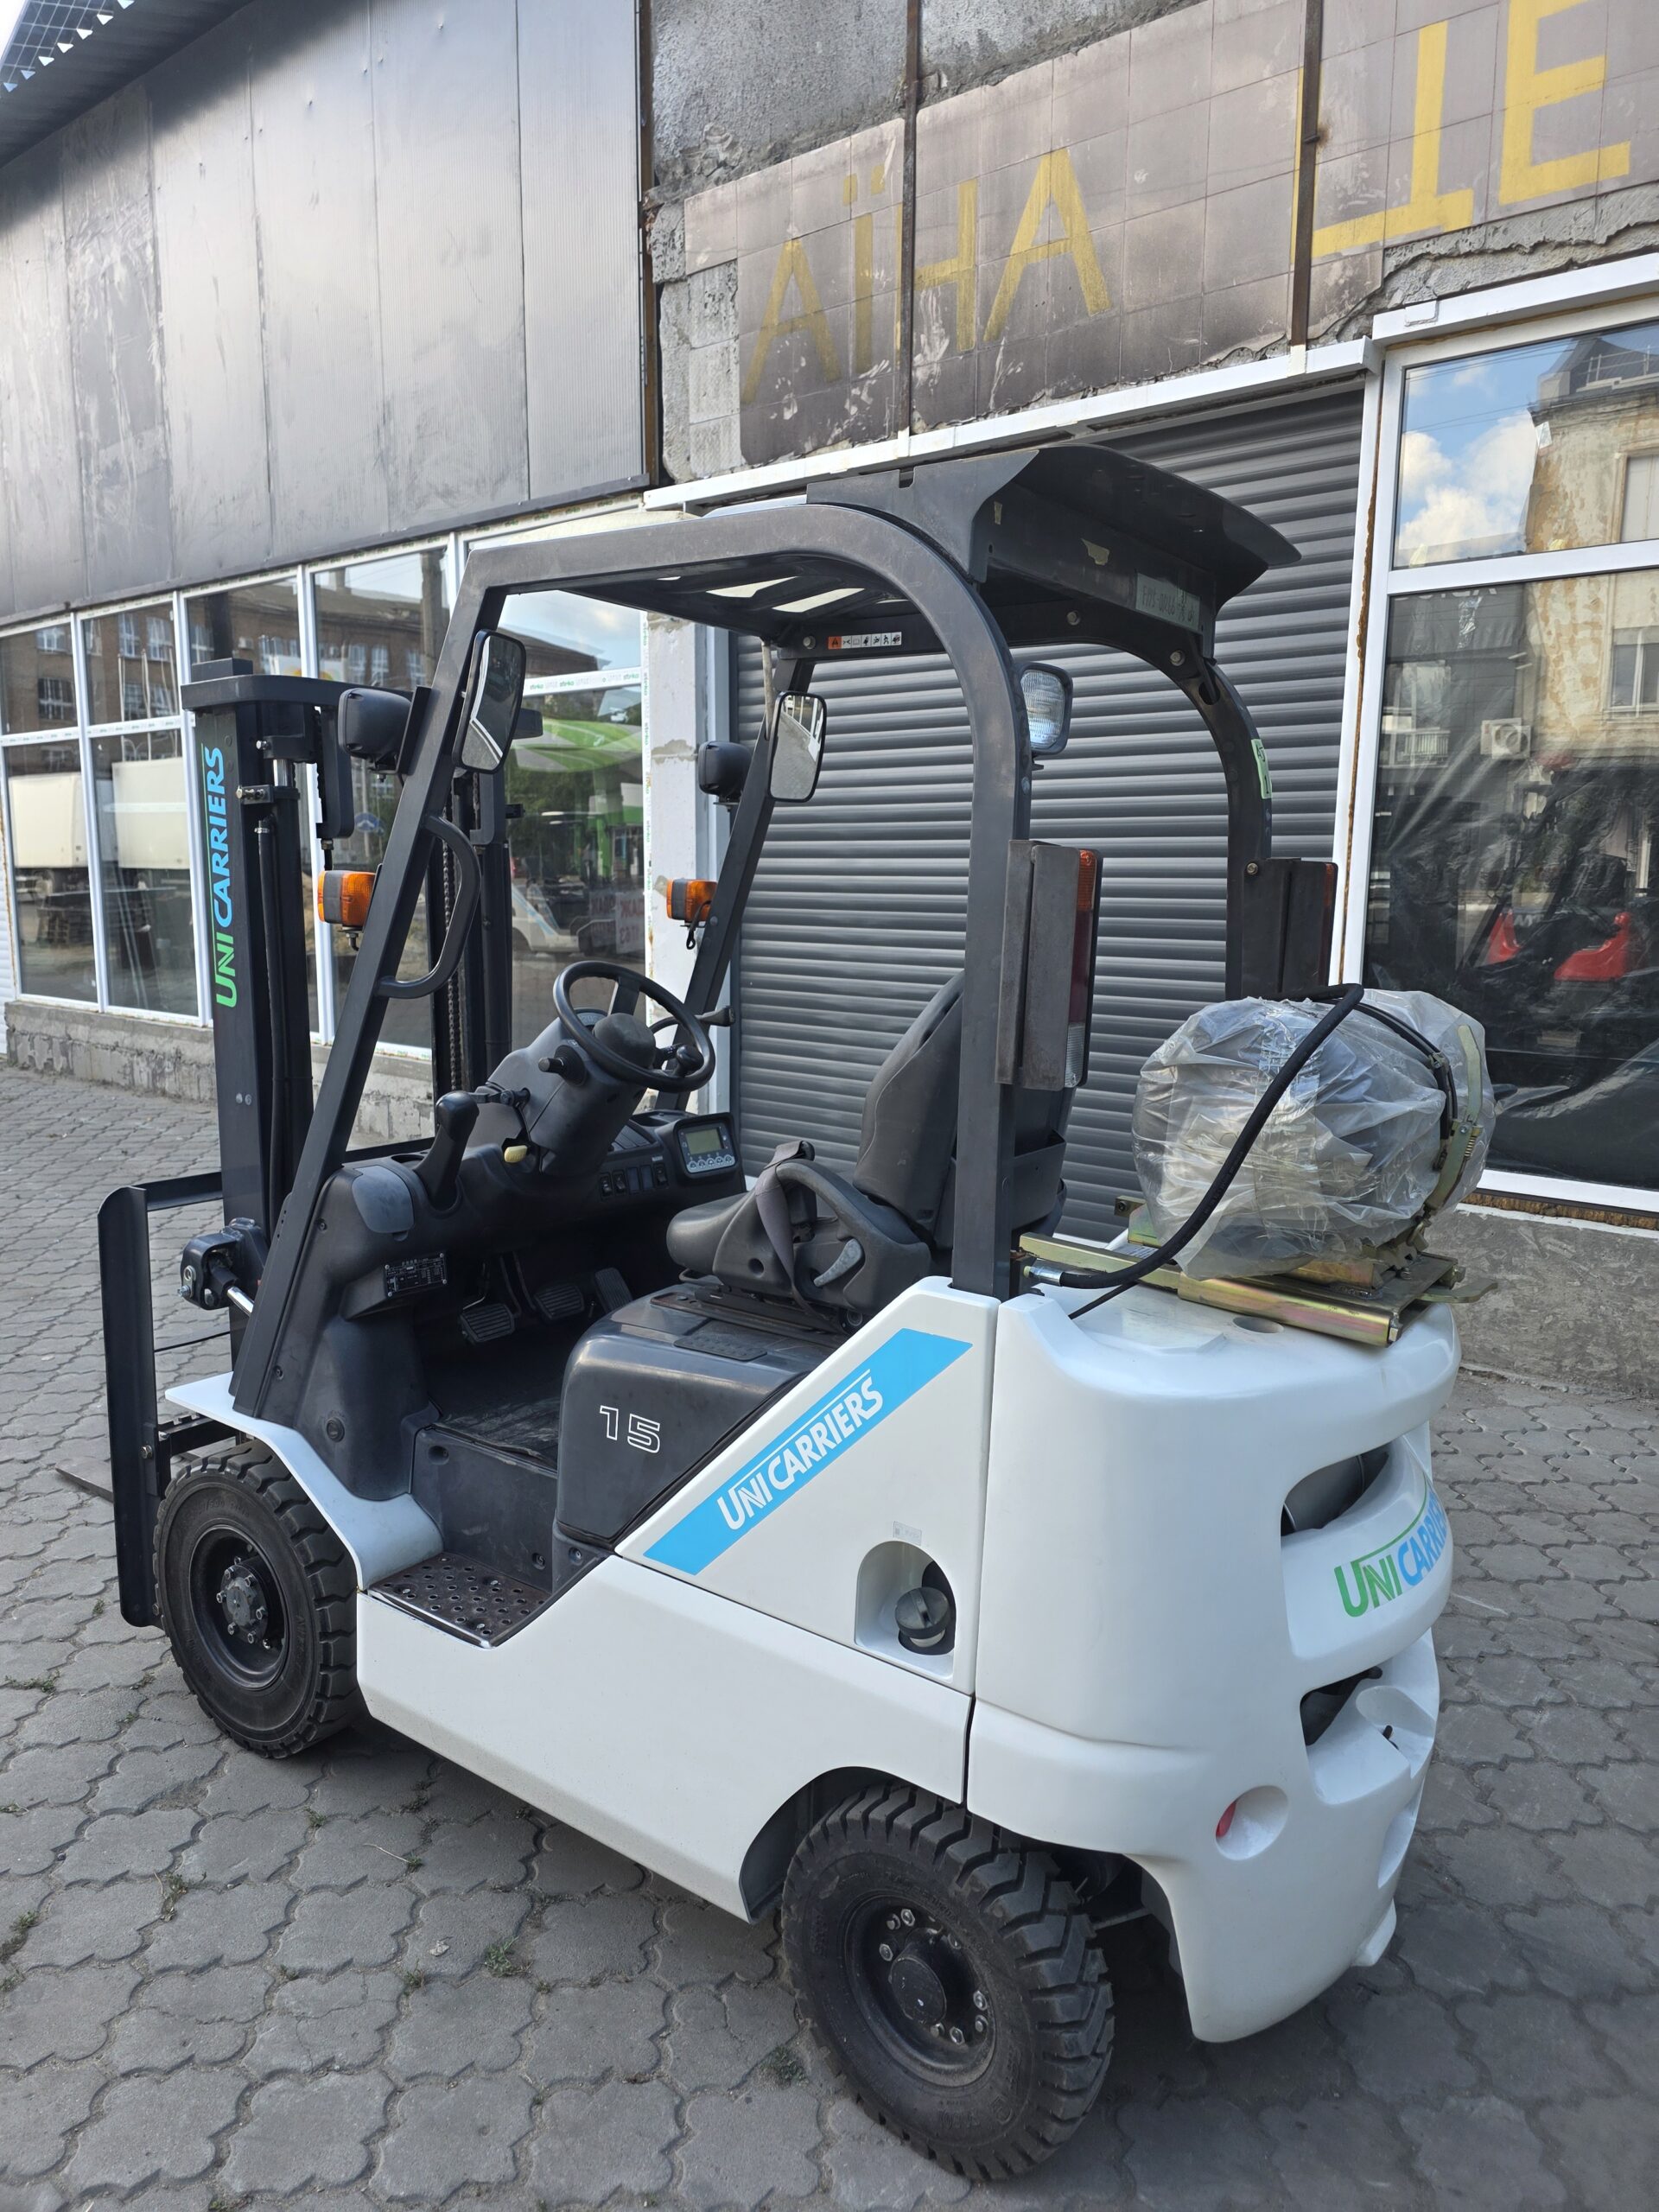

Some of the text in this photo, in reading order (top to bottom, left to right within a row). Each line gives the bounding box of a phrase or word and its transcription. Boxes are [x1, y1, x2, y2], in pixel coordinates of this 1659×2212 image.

[201, 744, 238, 1007] UNICARRIERS
[600, 1405, 661, 1453] 15
[716, 1370, 883, 1530] UNICARRIERS
